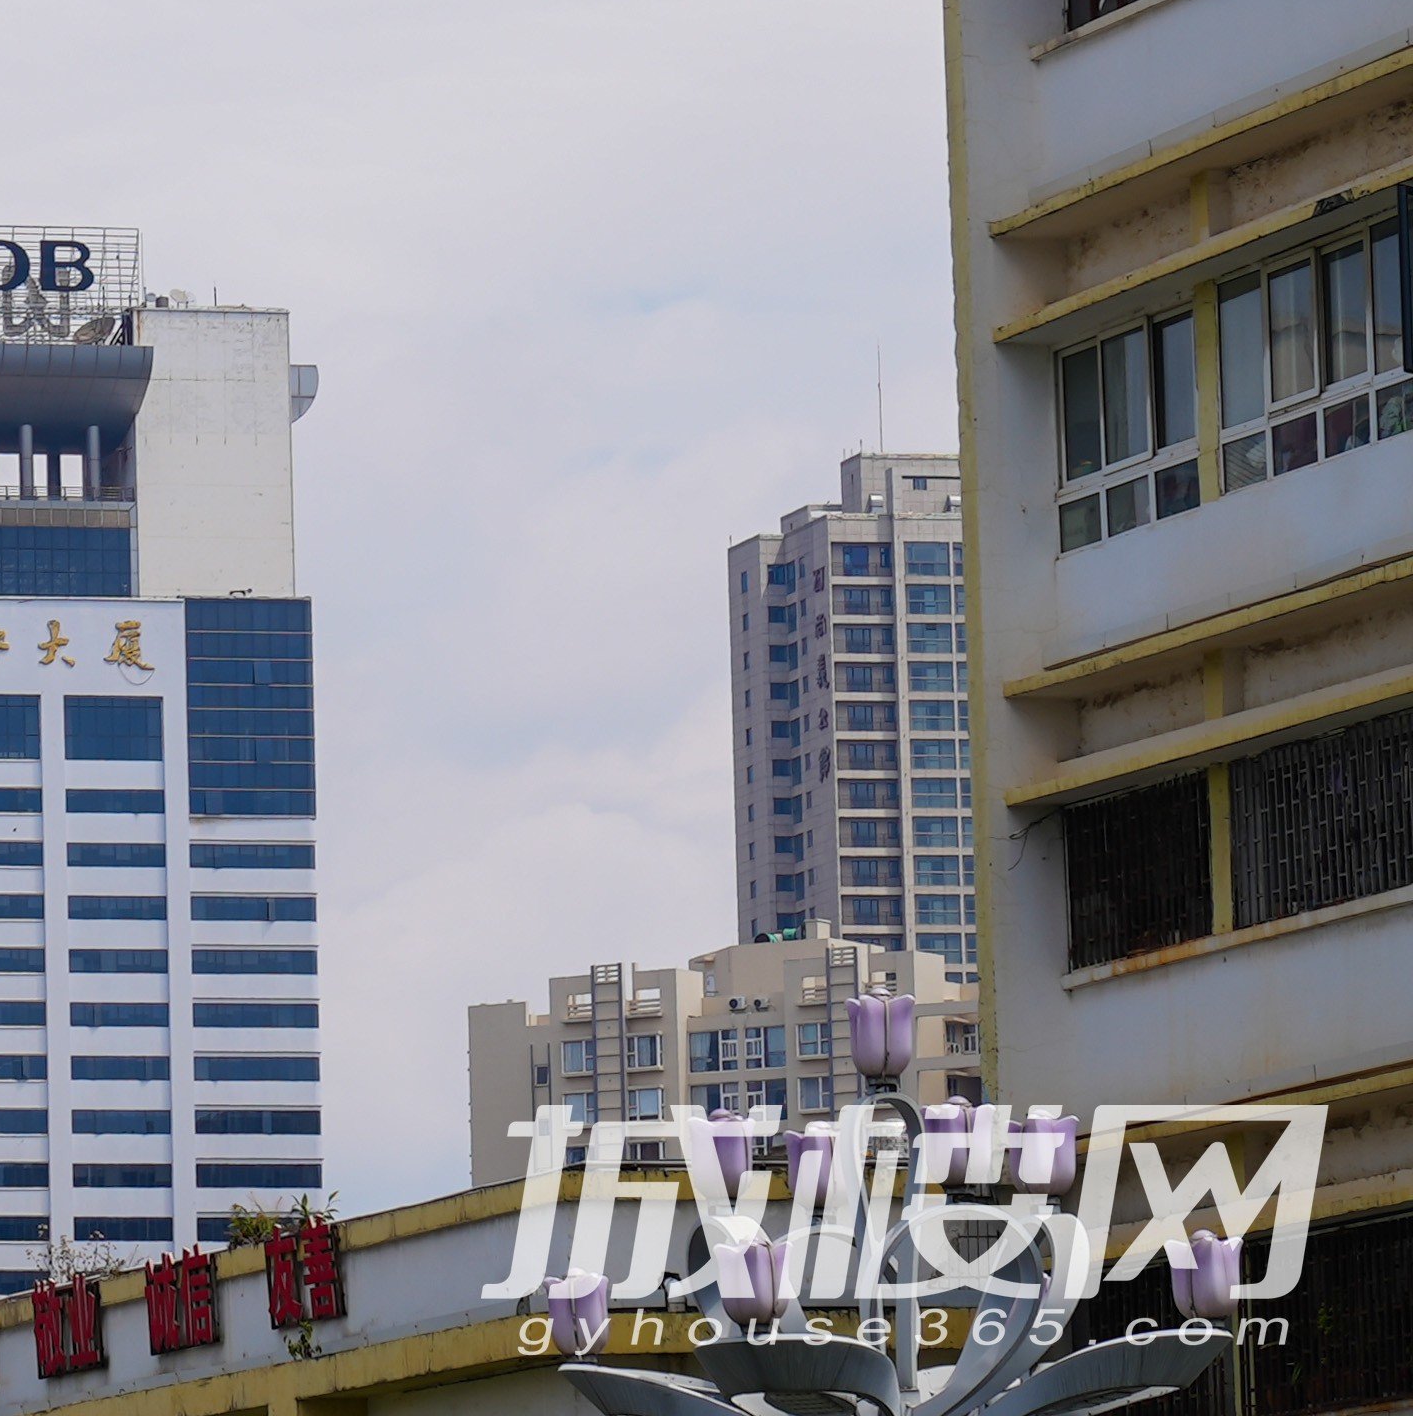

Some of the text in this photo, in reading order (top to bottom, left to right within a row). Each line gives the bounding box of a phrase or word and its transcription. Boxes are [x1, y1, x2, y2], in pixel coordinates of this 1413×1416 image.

[32, 1272, 102, 1378] 敬业
[145, 1243, 214, 1353] 诚信
[265, 1214, 340, 1327] 友善
